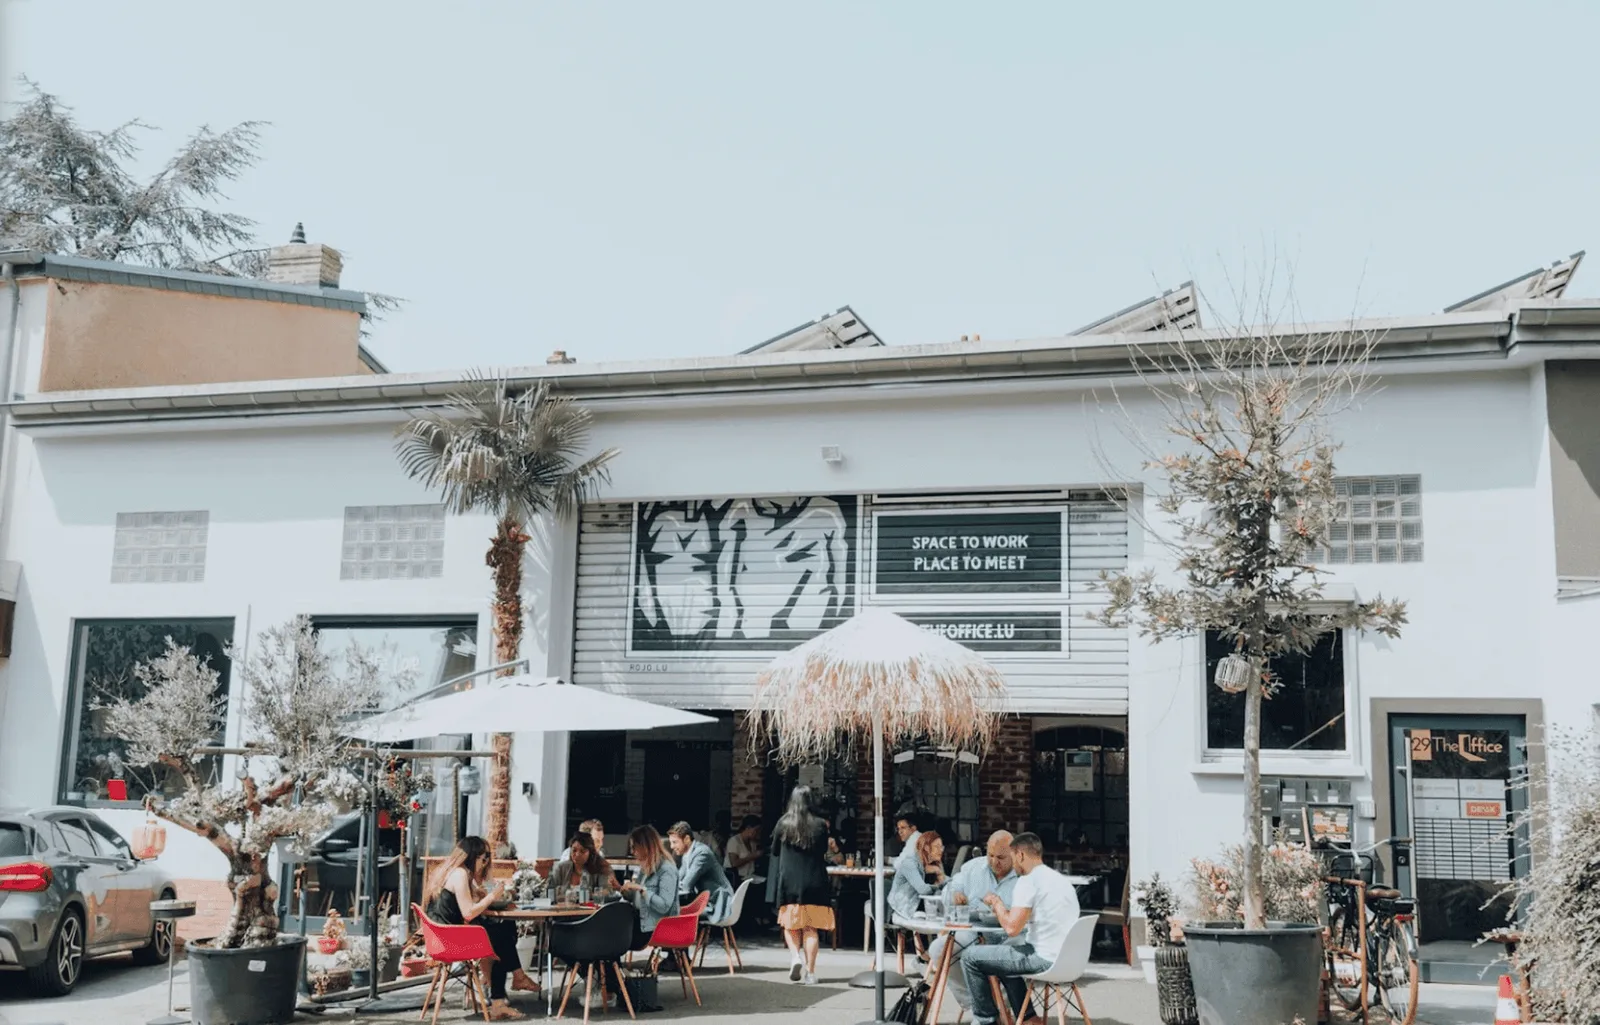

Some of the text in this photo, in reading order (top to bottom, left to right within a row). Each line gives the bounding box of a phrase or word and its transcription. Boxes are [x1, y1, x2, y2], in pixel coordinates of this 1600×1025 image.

[912, 535, 1029, 549] SPACE TO WORK
[914, 556, 1027, 571] PLACE TO MEET
[1412, 737, 1431, 752] 29
[1432, 736, 1458, 752] The
